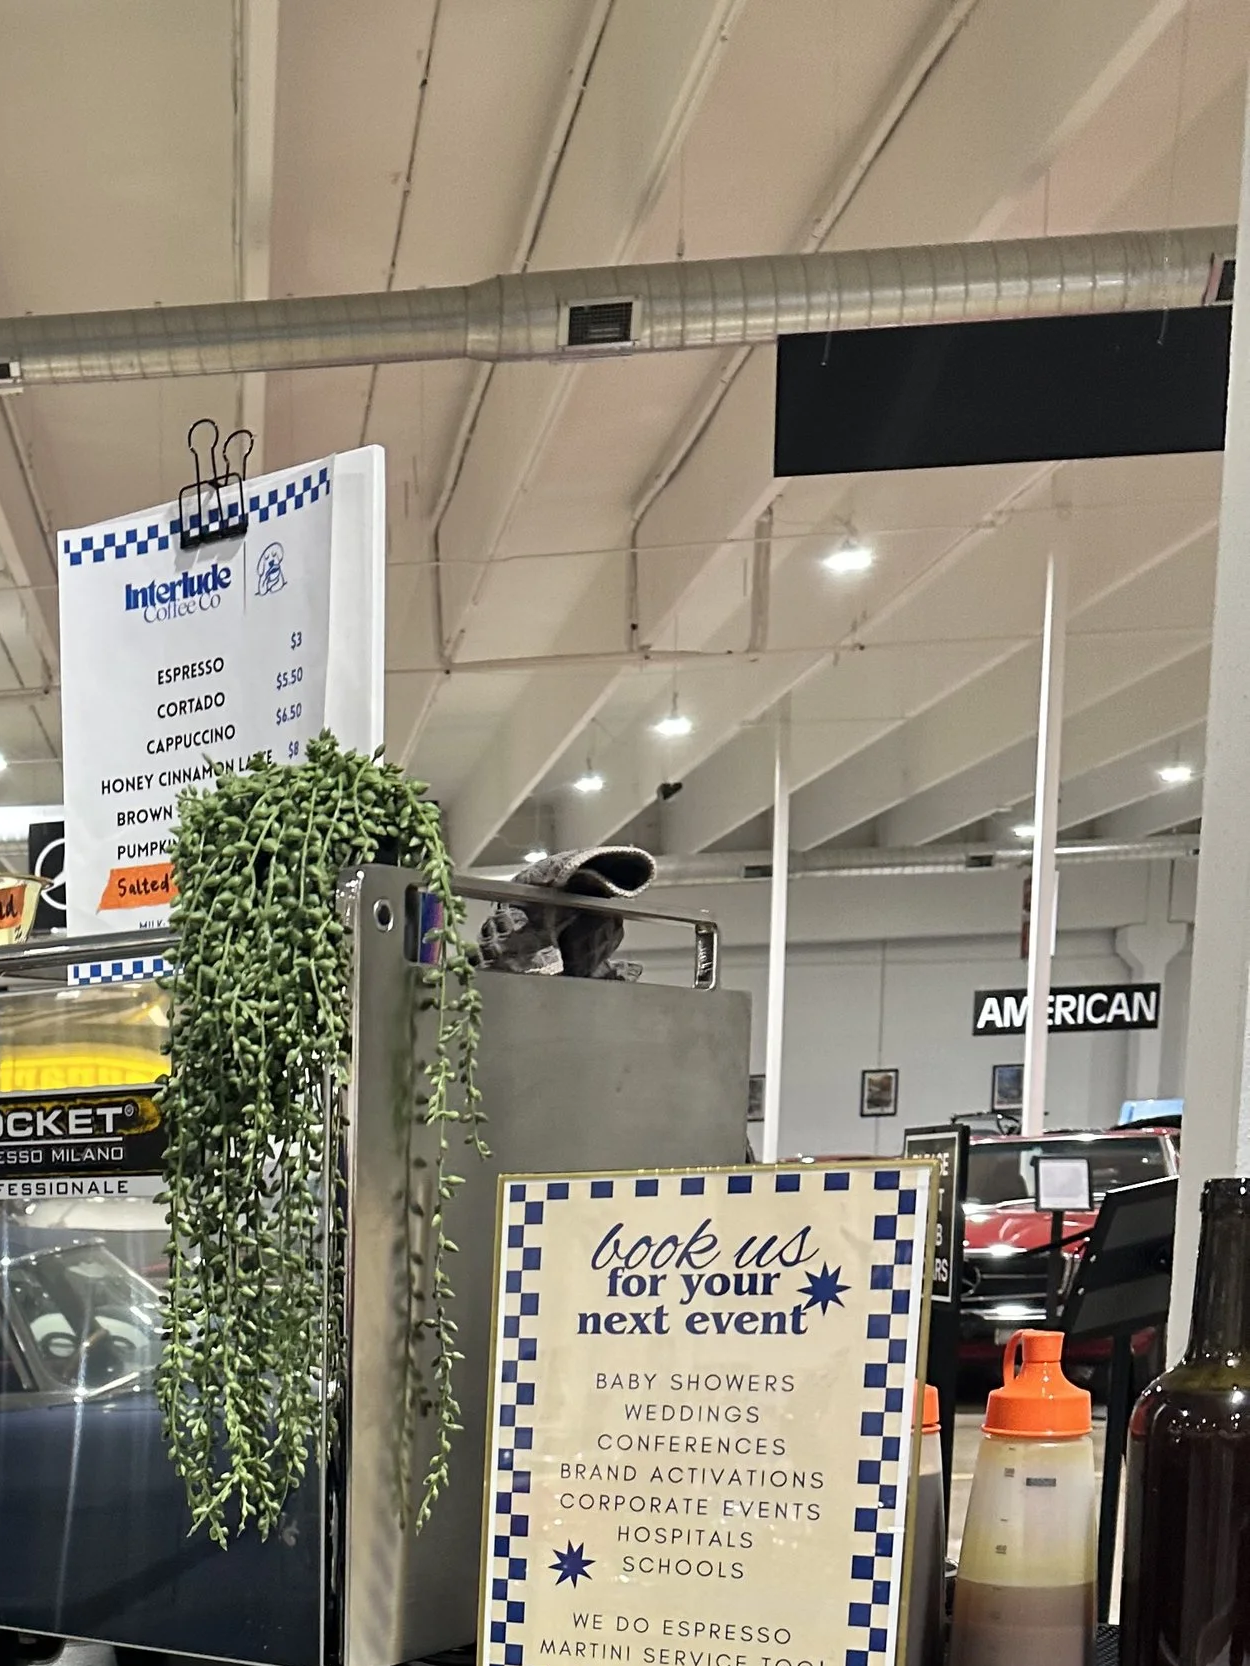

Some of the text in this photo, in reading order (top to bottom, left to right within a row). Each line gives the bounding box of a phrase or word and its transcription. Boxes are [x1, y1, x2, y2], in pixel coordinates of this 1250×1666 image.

[125, 563, 232, 611] Interlude
[143, 593, 221, 623] Coffee Co
[291, 631, 303, 650] $3
[157, 657, 225, 685] ESPRESSO
[276, 667, 303, 691] $5.50
[157, 692, 225, 719] CORTADO
[276, 702, 302, 726] $6.50
[146, 724, 236, 755] CAPPUCCINO
[288, 740, 300, 760] $8
[101, 773, 154, 795] HONEY
[158, 758, 234, 787] CINNAMON
[117, 805, 173, 827] BROWN
[117, 873, 170, 898] Salted
[52, 1146, 124, 1163] MILANO
[591, 1217, 819, 1270] book us
[607, 1267, 781, 1304] for your
[578, 1304, 808, 1335] next event
[596, 1373, 796, 1393] BABY SHOWERS
[624, 1404, 760, 1424] WEDDINGS
[597, 1434, 786, 1456] CONFERENCES
[560, 1464, 825, 1490] BRAND ACTIVATIONS
[559, 1493, 821, 1521] CORPORATE EVENTS
[617, 1526, 754, 1549] HOSPITALS
[622, 1555, 745, 1580] SCHOOLS
[572, 1612, 792, 1645] WE DO ESPRESSO
[539, 1640, 631, 1662] MARTINI
